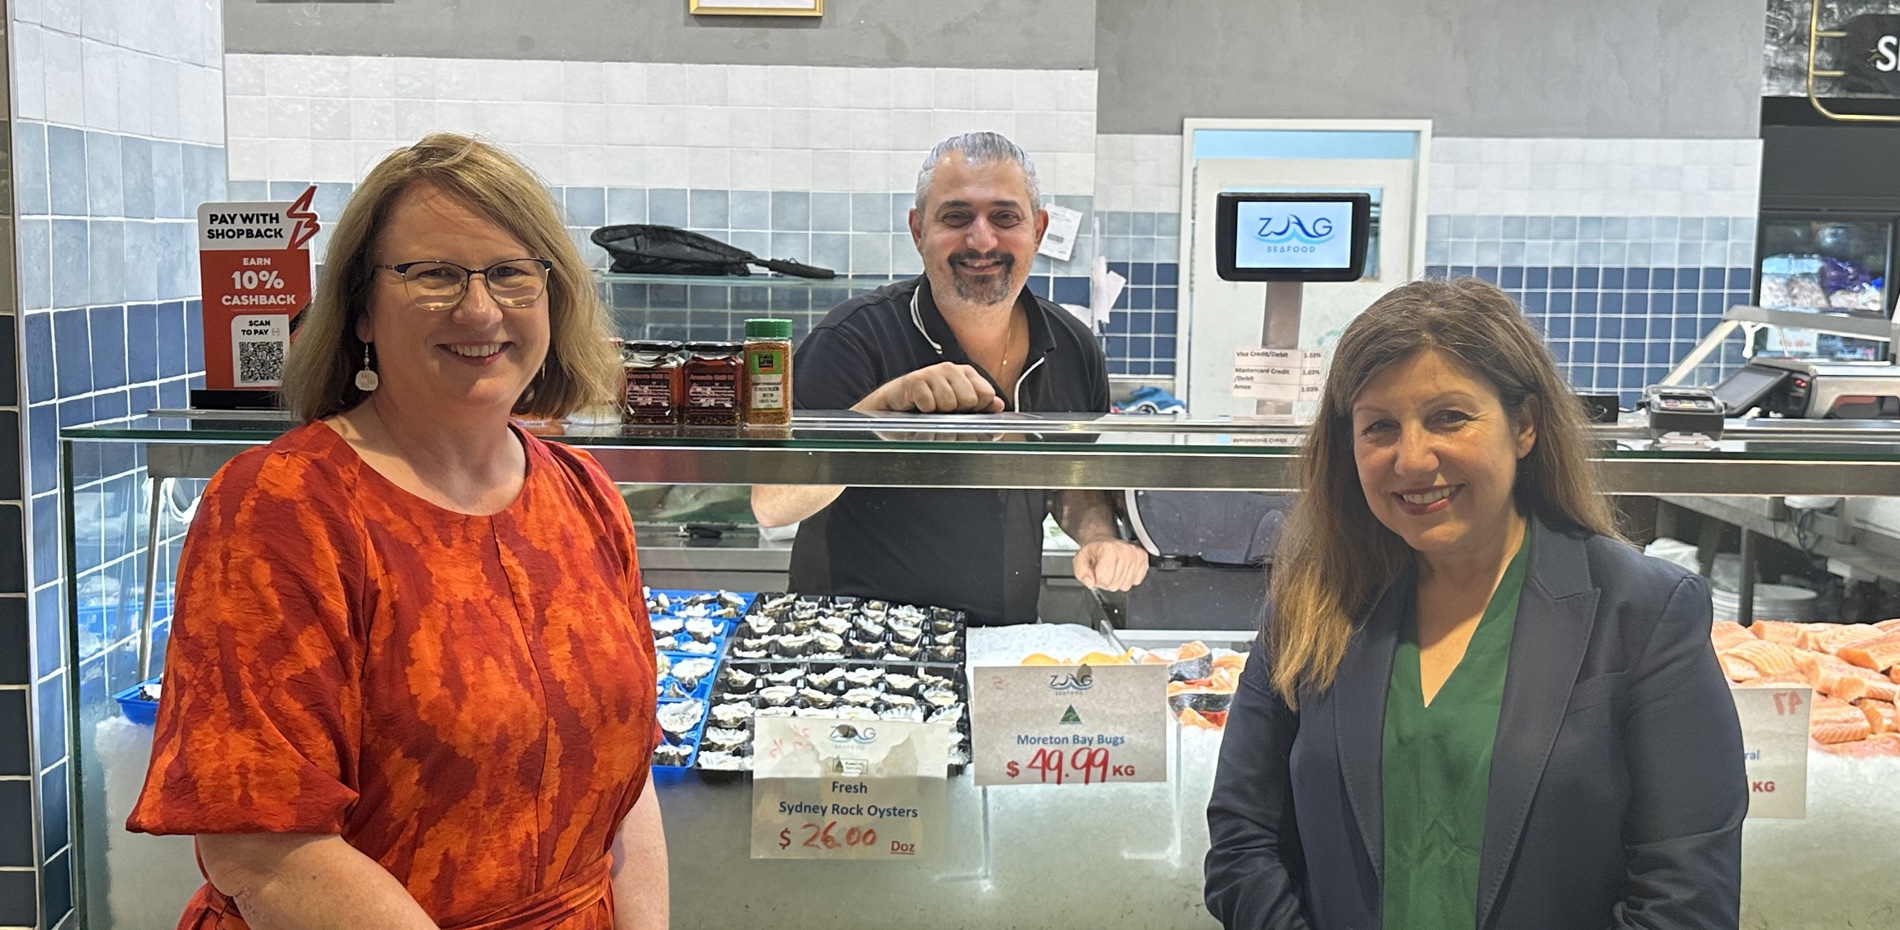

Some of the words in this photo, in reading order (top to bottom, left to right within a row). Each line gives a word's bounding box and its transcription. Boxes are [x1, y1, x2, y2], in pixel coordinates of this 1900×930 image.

[1876, 35, 1900, 72] S
[209, 213, 238, 225] PAY
[241, 212, 280, 224] WITH
[1257, 213, 1334, 239] ZAG
[207, 228, 284, 239] SHOPBACK
[1266, 245, 1316, 253] SEAFOOD
[243, 257, 271, 266] EARN
[231, 270, 285, 290] 10%
[221, 295, 297, 306] CASHBACK
[1016, 734, 1069, 745] Moreton
[1072, 734, 1094, 746] Bay
[1097, 734, 1125, 746] Bugs
[1006, 760, 1020, 778] $
[1026, 747, 1110, 785] 49.99
[1112, 765, 1136, 777] KG
[831, 781, 868, 794] Fresh
[1752, 781, 1776, 792] KG
[779, 801, 828, 816] Sydney
[831, 803, 864, 816] Rock
[867, 804, 918, 819] Oysters
[779, 827, 792, 850] $
[890, 840, 915, 853] Doz
